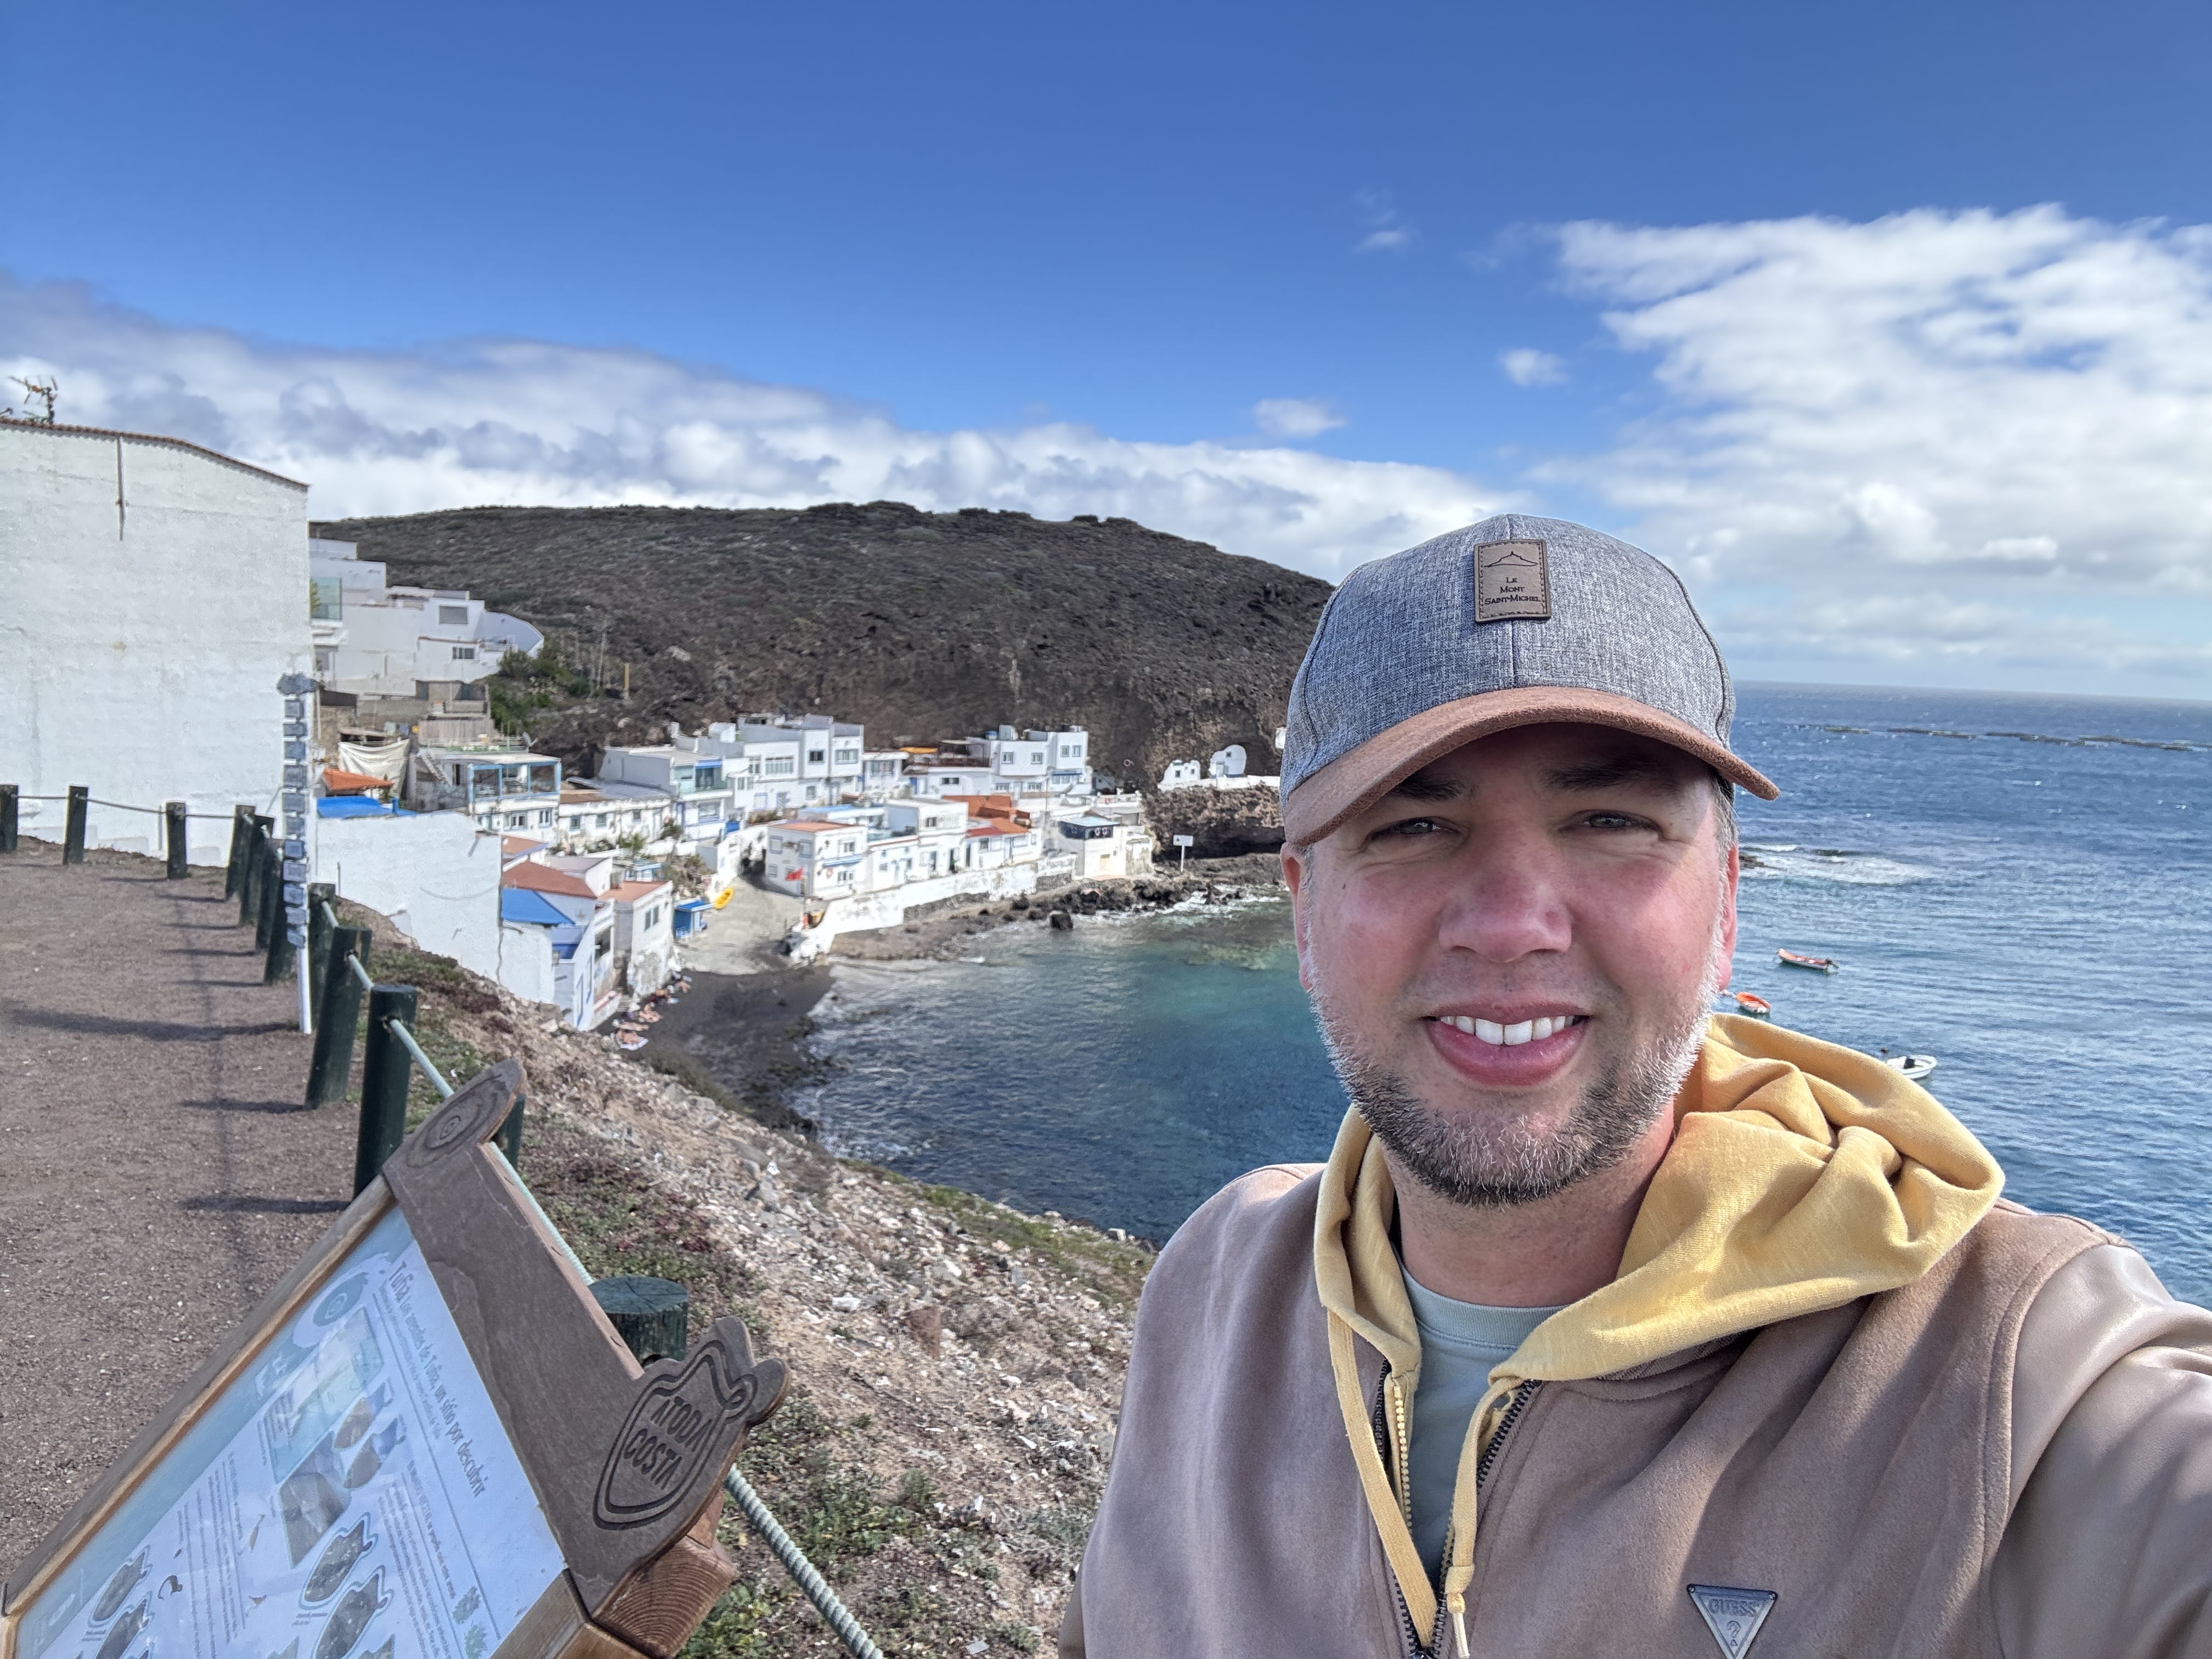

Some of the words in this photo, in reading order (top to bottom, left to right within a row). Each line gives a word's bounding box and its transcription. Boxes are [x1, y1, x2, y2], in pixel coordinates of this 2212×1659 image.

[1485, 594, 1541, 605] SAINT-MICHEL
[456, 1438, 488, 1498] descubrir
[623, 1428, 682, 1491] COSTA
[1707, 1598, 1760, 1617] GUESS
